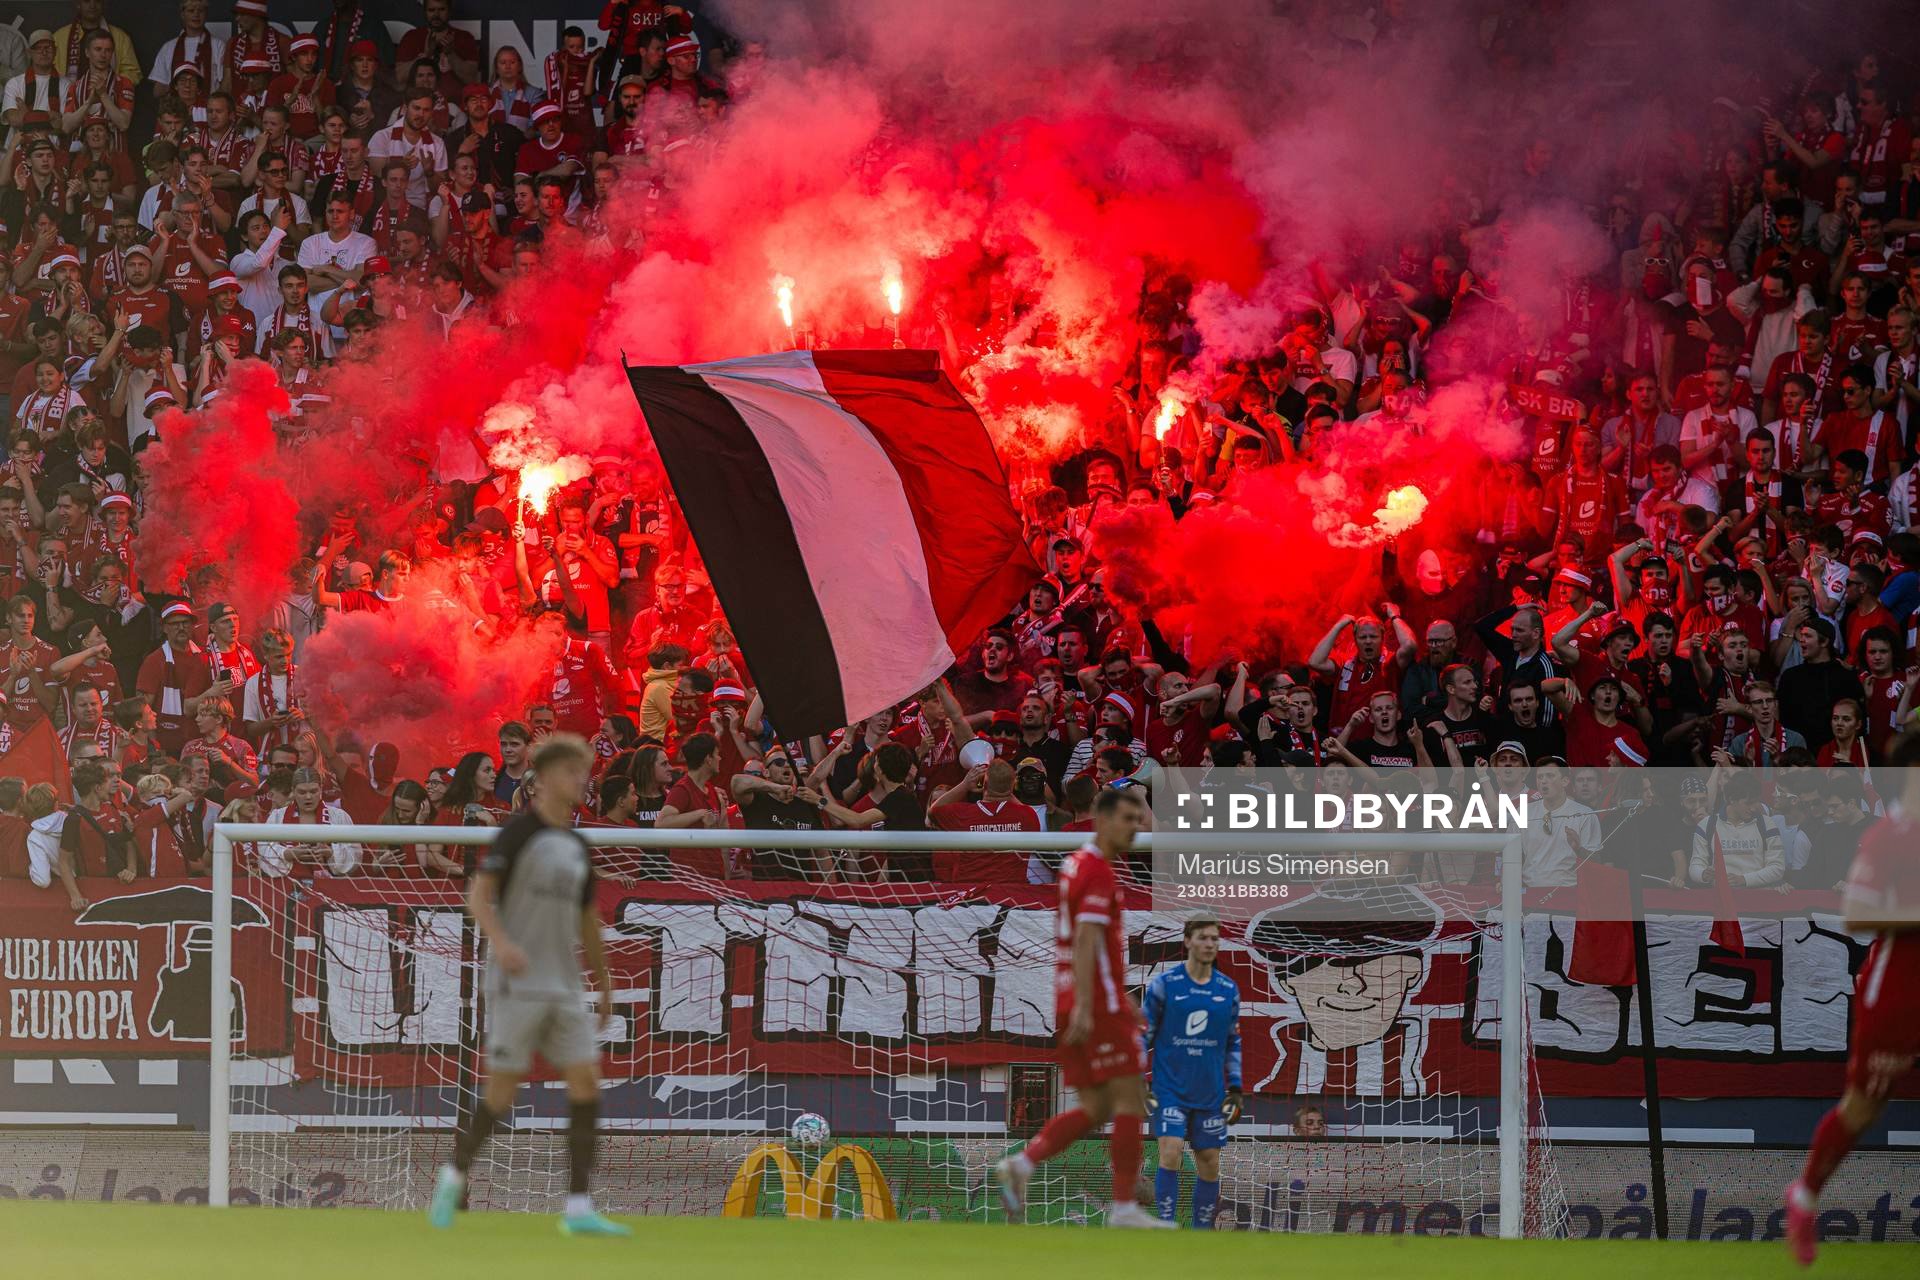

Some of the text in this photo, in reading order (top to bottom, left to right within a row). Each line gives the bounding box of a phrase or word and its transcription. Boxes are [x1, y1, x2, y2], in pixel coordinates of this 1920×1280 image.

[1517, 390, 1542, 410] SK
[1720, 839, 1760, 849] ELSINKI
[0, 937, 138, 981] UBLIKKEN
[9, 988, 138, 1040] EUROPA
